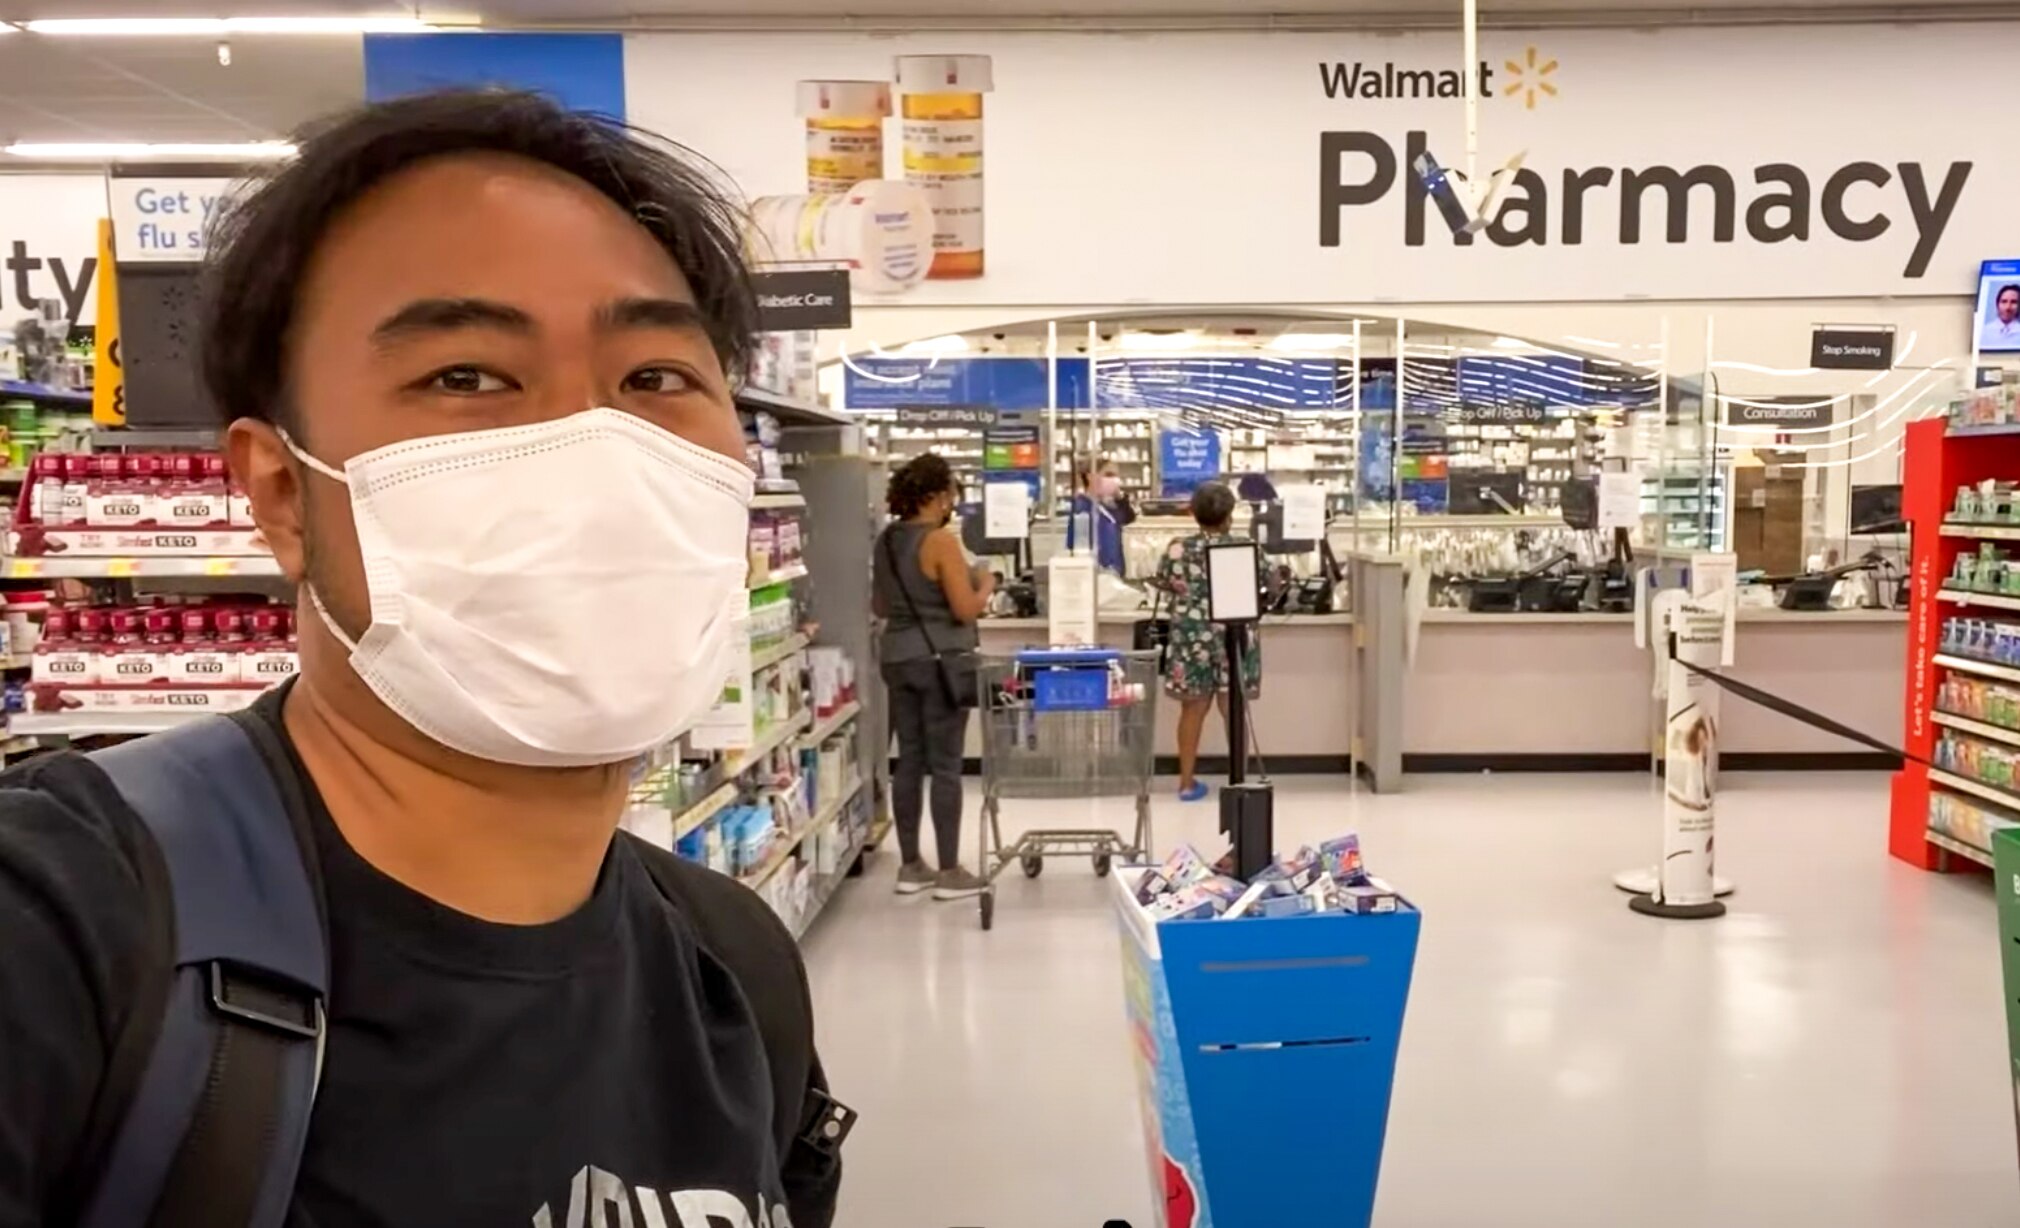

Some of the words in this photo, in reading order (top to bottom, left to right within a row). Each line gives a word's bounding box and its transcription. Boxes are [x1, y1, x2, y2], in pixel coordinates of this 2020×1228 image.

[135, 188, 190, 213] Get
[1319, 130, 1973, 278] Pharmacy
[138, 223, 176, 248] flu
[0, 240, 98, 326] ty
[804, 293, 833, 307] Care
[1843, 344, 1881, 357] Smoking
[978, 410, 995, 423] Up
[1526, 407, 1542, 421] Up
[1743, 407, 1817, 419] Consultation
[104, 505, 139, 515] KETO
[174, 506, 209, 516] KETO
[157, 537, 195, 547] KETO
[1919, 577, 1928, 599] of
[1917, 601, 1927, 643] care
[50, 662, 85, 672] KETO
[118, 663, 153, 673] KETO
[187, 662, 222, 672] KETO
[258, 662, 293, 672] KETO
[1915, 646, 1926, 689] take
[169, 694, 207, 705] KETO
